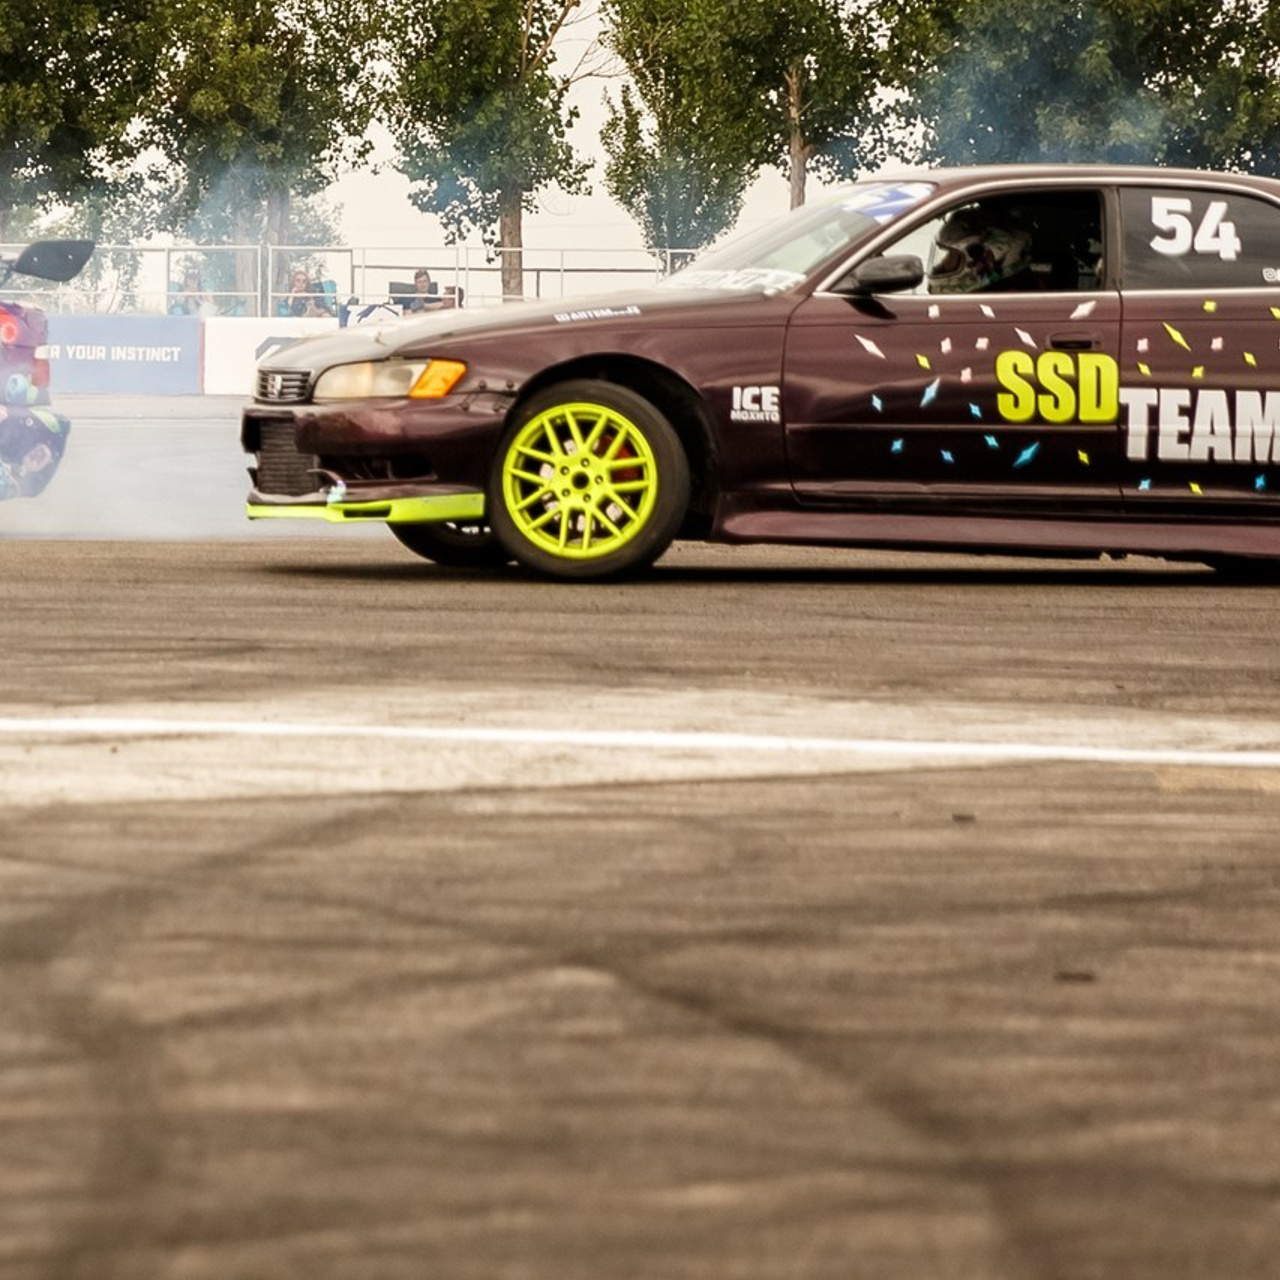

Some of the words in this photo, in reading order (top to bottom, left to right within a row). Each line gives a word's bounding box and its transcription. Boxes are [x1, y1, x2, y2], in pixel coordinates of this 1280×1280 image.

[1149, 196, 1242, 260] 54
[66, 345, 106, 360] YOUR
[111, 346, 181, 361] INSTINCT
[732, 386, 780, 411] ICE
[995, 350, 1118, 422] SSD
[1118, 387, 1280, 462] TEAM
